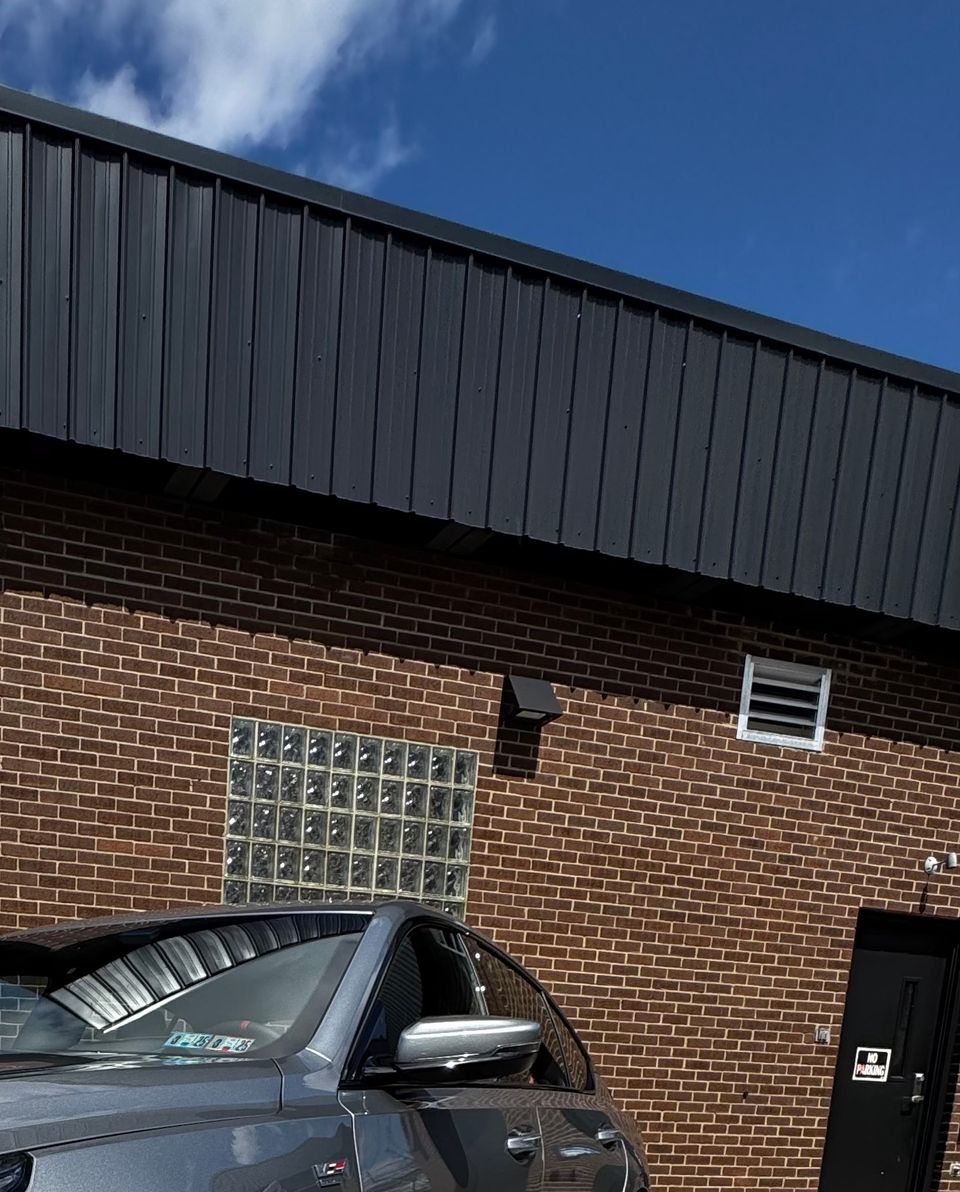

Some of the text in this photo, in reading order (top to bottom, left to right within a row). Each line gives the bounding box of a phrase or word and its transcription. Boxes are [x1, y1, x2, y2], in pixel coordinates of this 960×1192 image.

[194, 1036, 210, 1046] 25
[235, 1041, 251, 1051] 25
[867, 1052, 878, 1063] NO
[856, 1064, 885, 1076] PARKING
